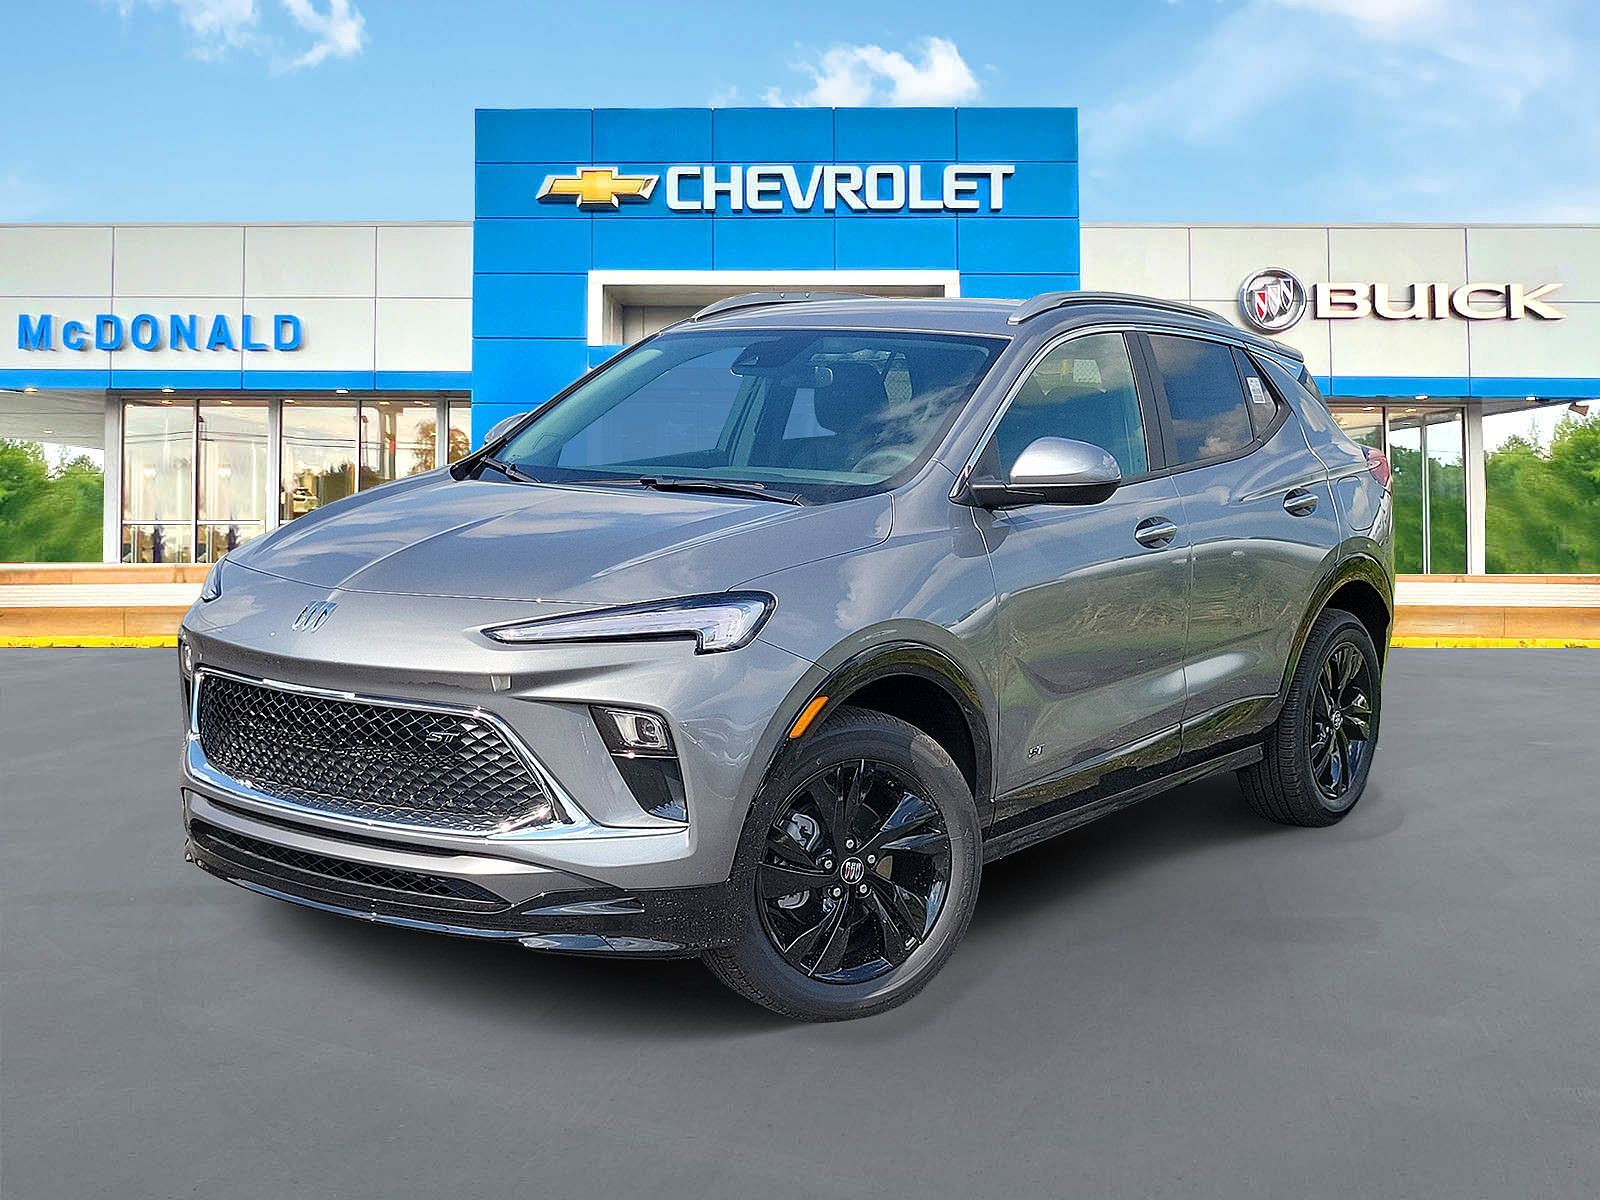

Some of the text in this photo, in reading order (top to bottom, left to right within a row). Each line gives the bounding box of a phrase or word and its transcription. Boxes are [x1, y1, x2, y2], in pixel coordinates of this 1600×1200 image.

[665, 164, 1015, 212] CHEVROLET
[1313, 282, 1567, 320] BUICK
[17, 313, 304, 351] McDONALD
